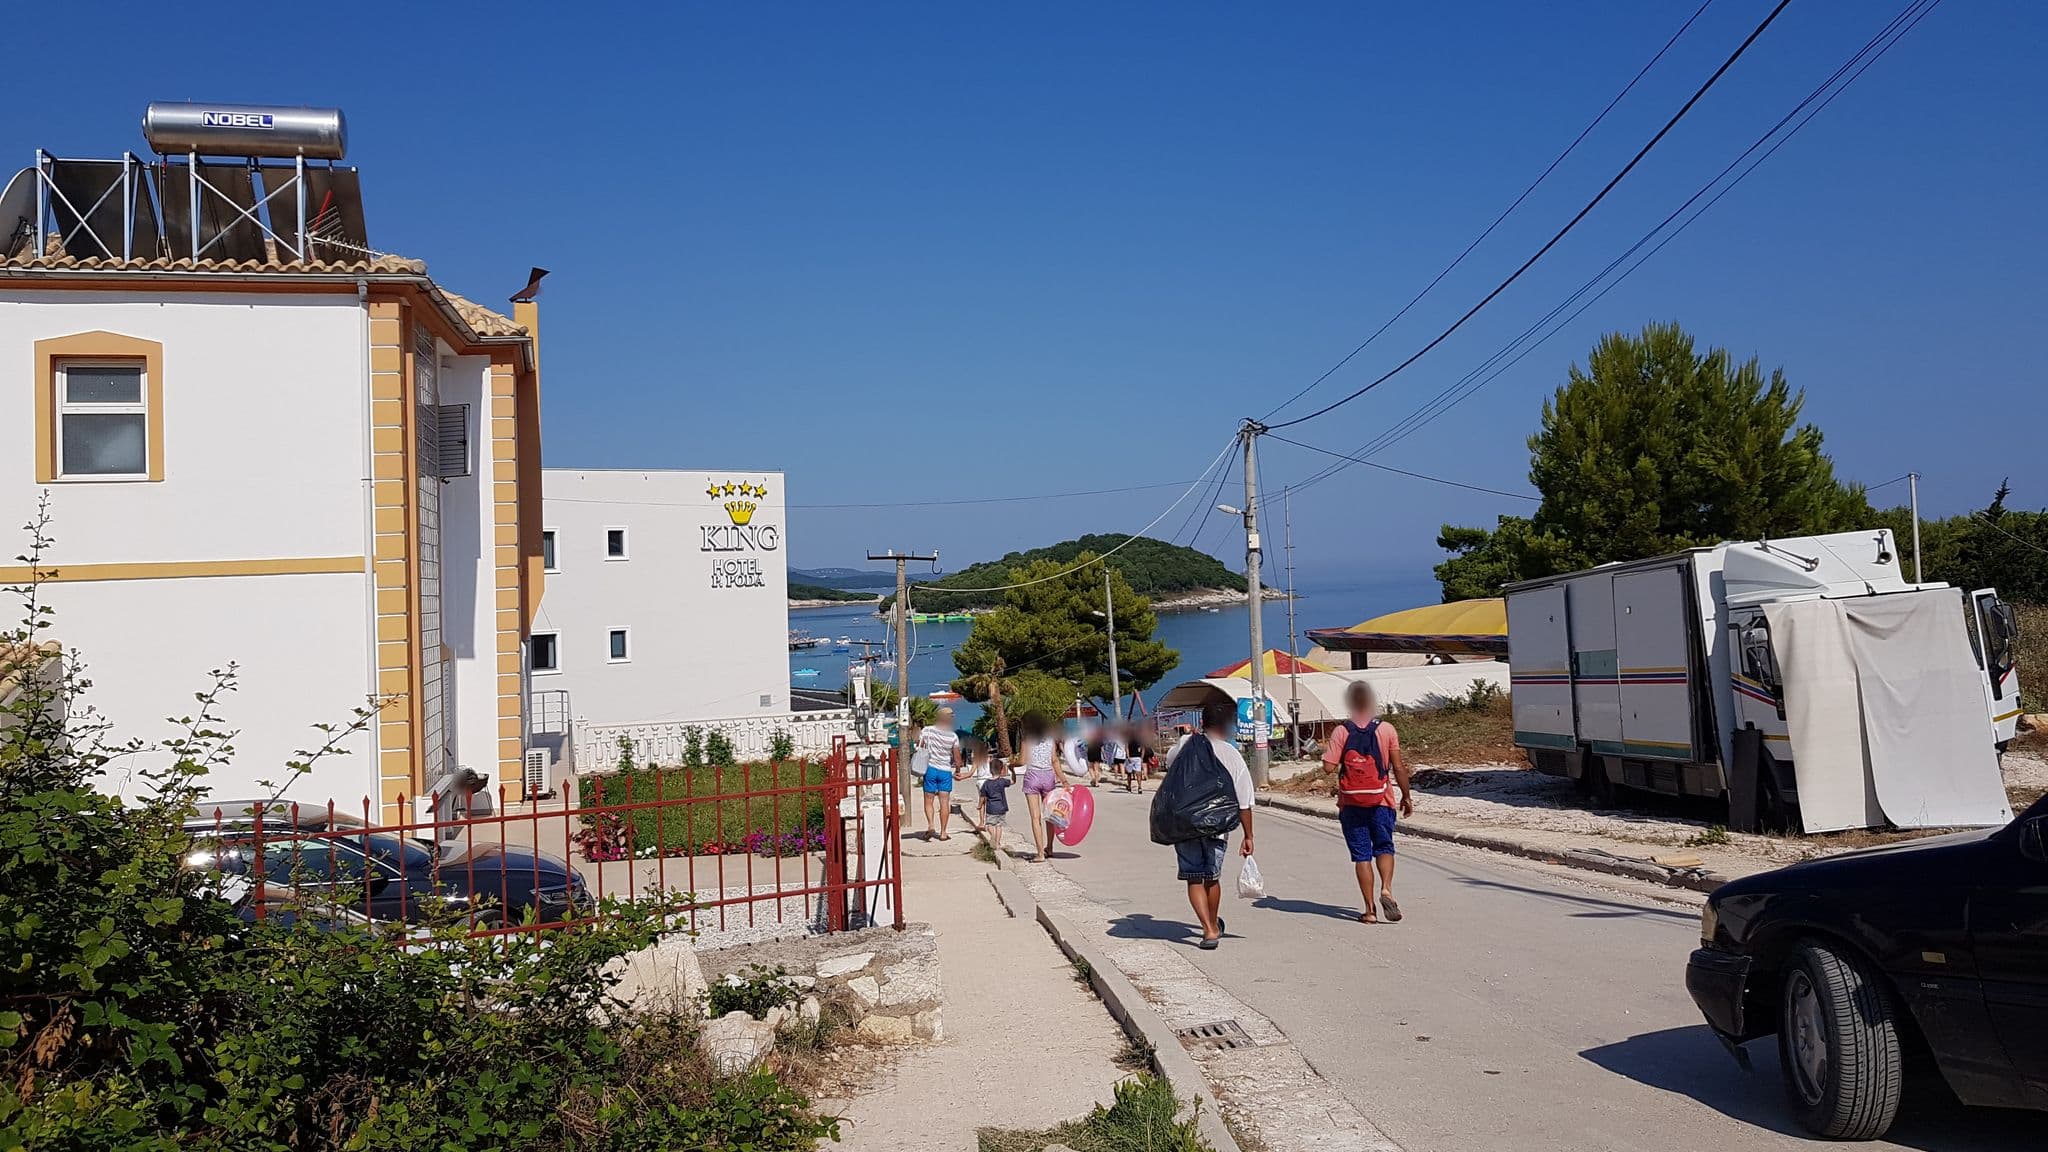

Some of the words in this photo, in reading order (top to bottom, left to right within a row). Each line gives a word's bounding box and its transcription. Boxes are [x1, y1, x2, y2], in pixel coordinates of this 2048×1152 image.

[204, 113, 272, 128] NOBEL
[700, 525, 779, 552] KING
[713, 558, 763, 576] HOTEL
[711, 575, 724, 588] P.
[726, 575, 765, 588] PODA
